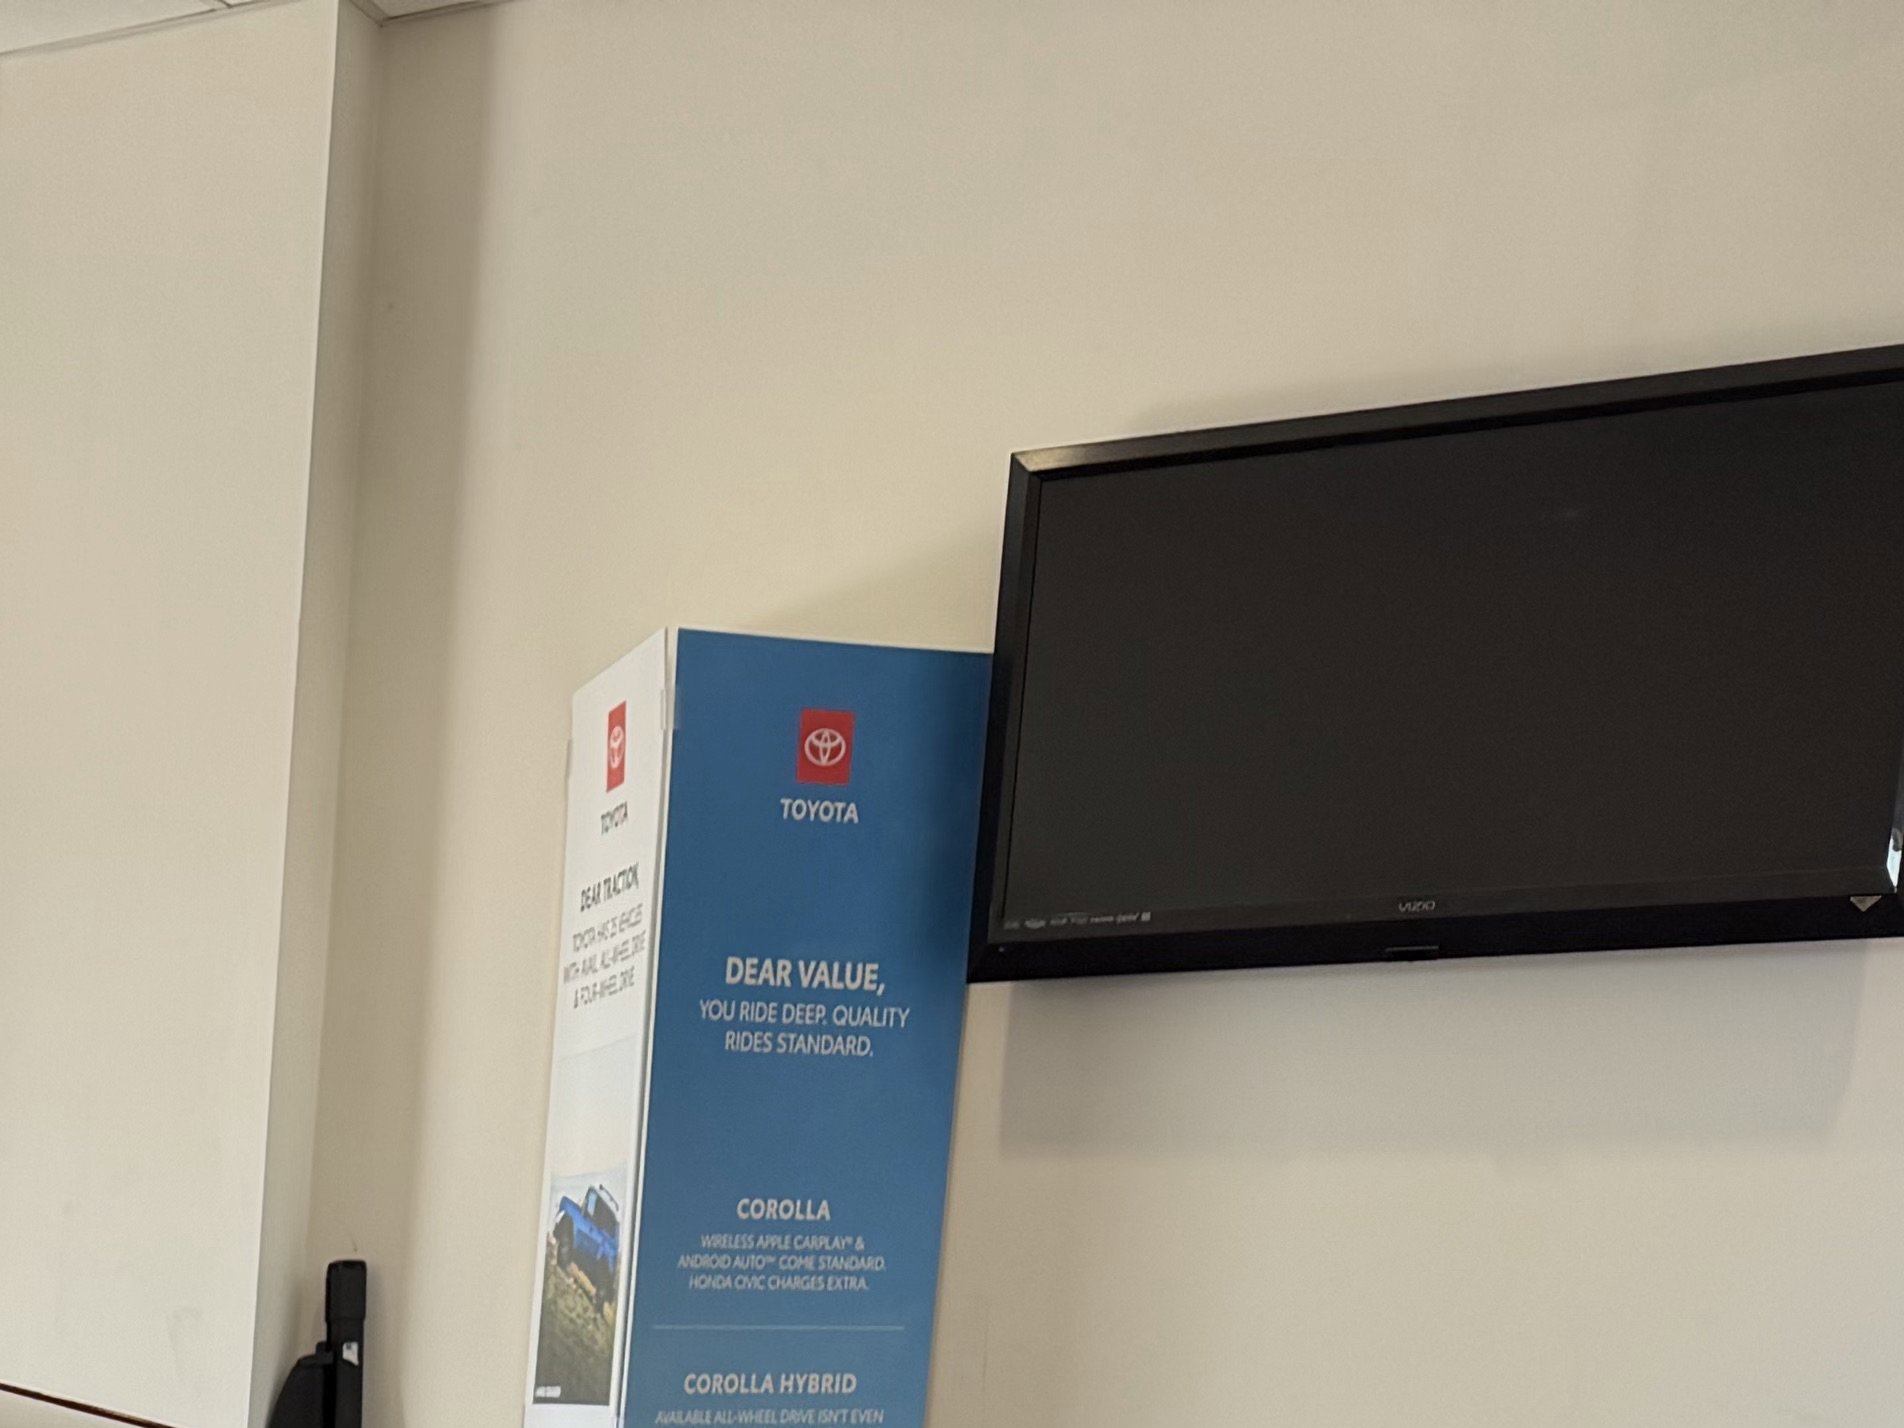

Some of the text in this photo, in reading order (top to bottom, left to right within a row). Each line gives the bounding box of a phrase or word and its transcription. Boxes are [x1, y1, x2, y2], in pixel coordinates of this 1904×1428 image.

[781, 798, 858, 824] TOYOTA
[725, 956, 885, 996] DEAR VALUE,
[699, 1000, 910, 1029] YOU RIDE DEEP. QUALITY
[724, 1031, 873, 1057] RIDES STANDARD.
[737, 1198, 831, 1221] COROLLA
[701, 1234, 754, 1250] WIRELESS
[756, 1234, 792, 1250] APPLE
[678, 1254, 731, 1269] ANDROID
[689, 1274, 732, 1289] HONDA
[767, 1275, 825, 1291] CHARGES
[684, 1373, 857, 1395] COROLLA HYBRID
[713, 1408, 777, 1425] ALL-WHEEL
[780, 1408, 816, 1424] DRIVE
[849, 1408, 884, 1424] EVEN
